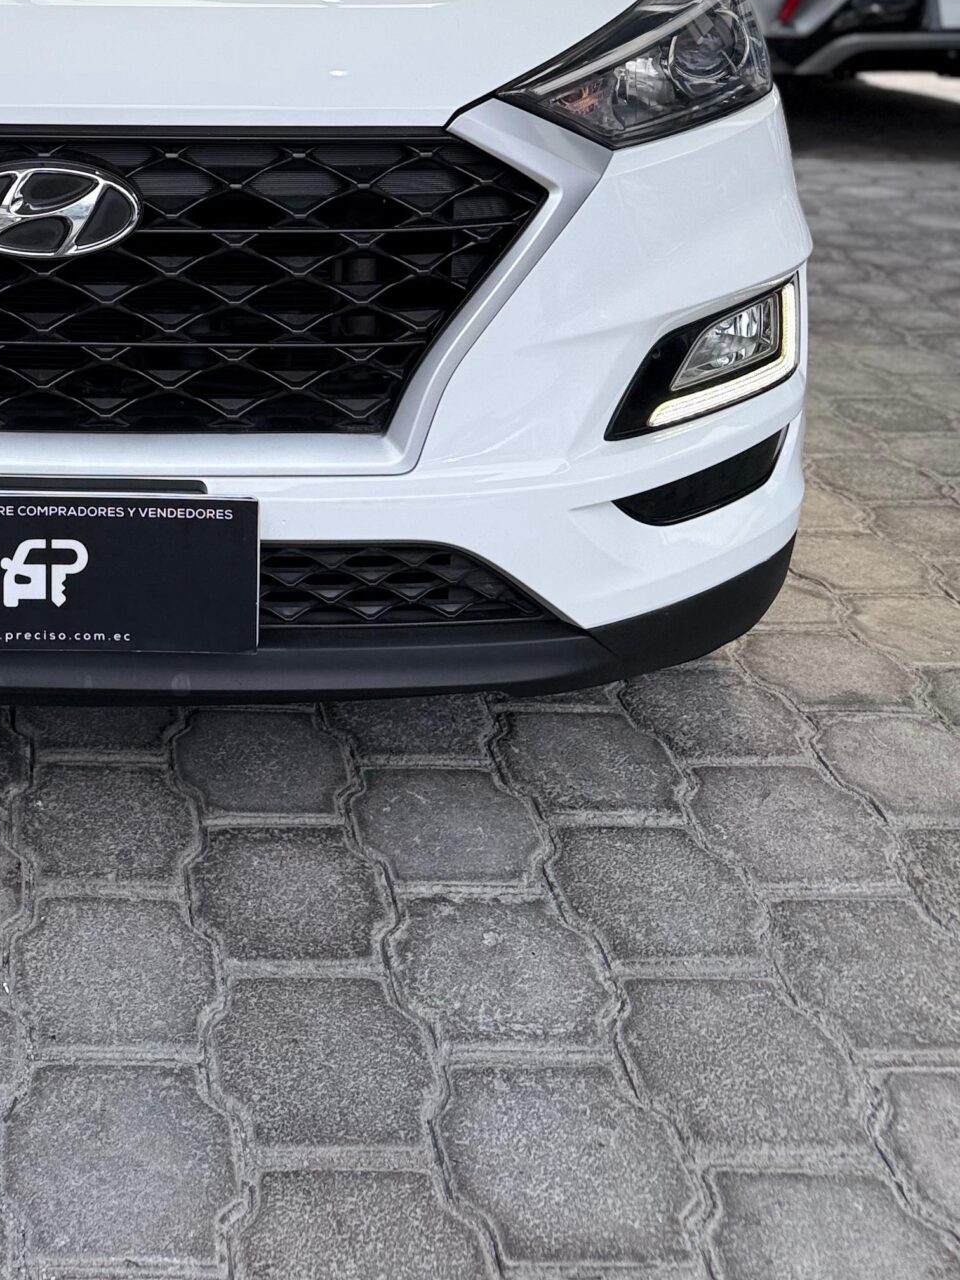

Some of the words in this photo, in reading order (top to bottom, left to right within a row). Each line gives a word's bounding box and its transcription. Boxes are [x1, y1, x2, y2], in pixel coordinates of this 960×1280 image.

[17, 505, 125, 518] COMPRADORES
[127, 507, 136, 518] Y
[138, 507, 234, 520] VENDEDORES
